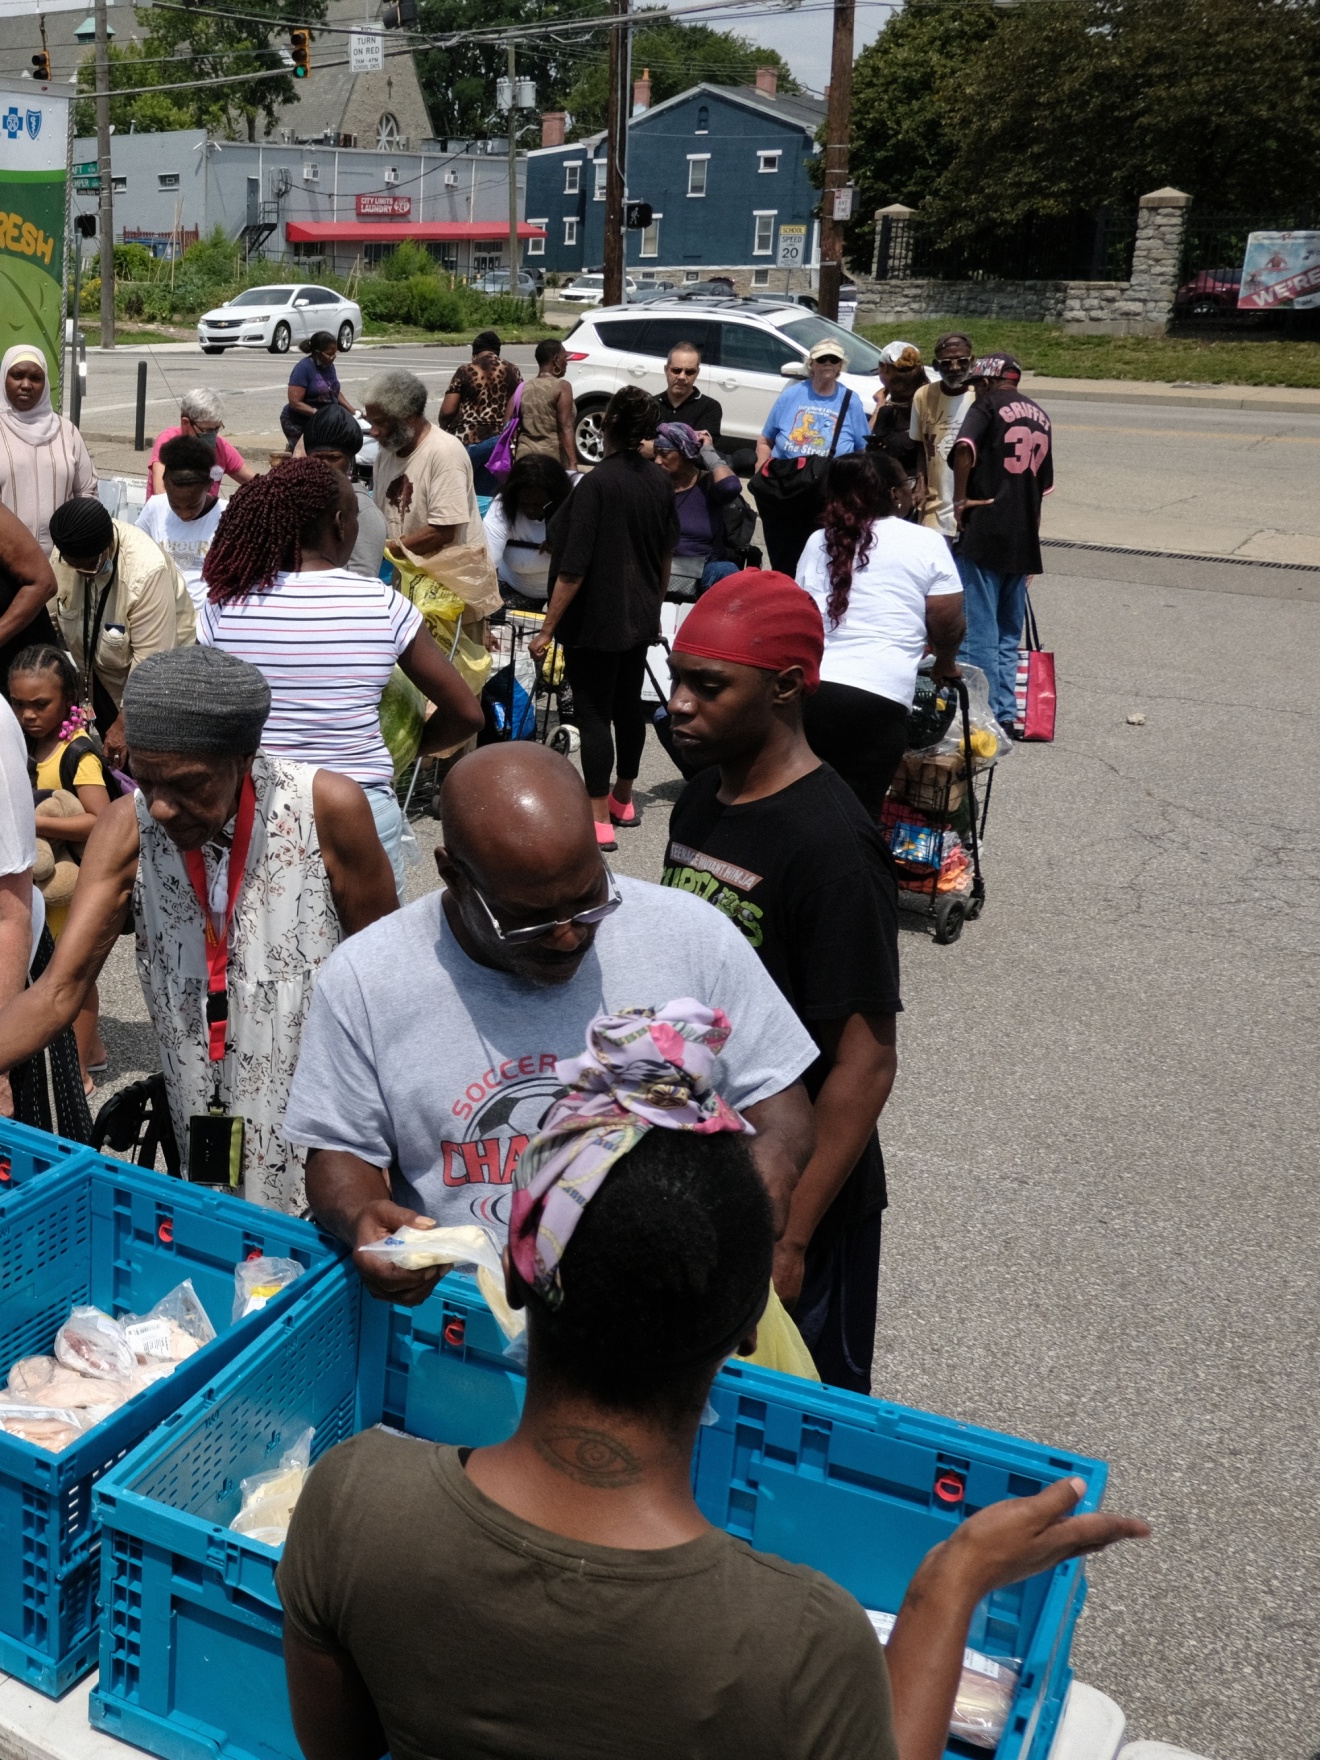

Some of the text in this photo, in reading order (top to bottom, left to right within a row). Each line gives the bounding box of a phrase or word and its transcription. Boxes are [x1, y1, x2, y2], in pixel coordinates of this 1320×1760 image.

[357, 36, 376, 45] TURN
[353, 46, 380, 56] ON RED
[374, 197, 393, 205] LIMITS
[360, 204, 393, 213] LAUNDRY
[782, 235, 802, 243] SPEED
[782, 247, 799, 259] 20
[1252, 268, 1320, 306] WE'RE
[783, 441, 800, 452] The
[1003, 426, 1049, 477] 30
[671, 844, 756, 889] TEENAGE MUTANT NINJA
[451, 1053, 559, 1121] SOCCER
